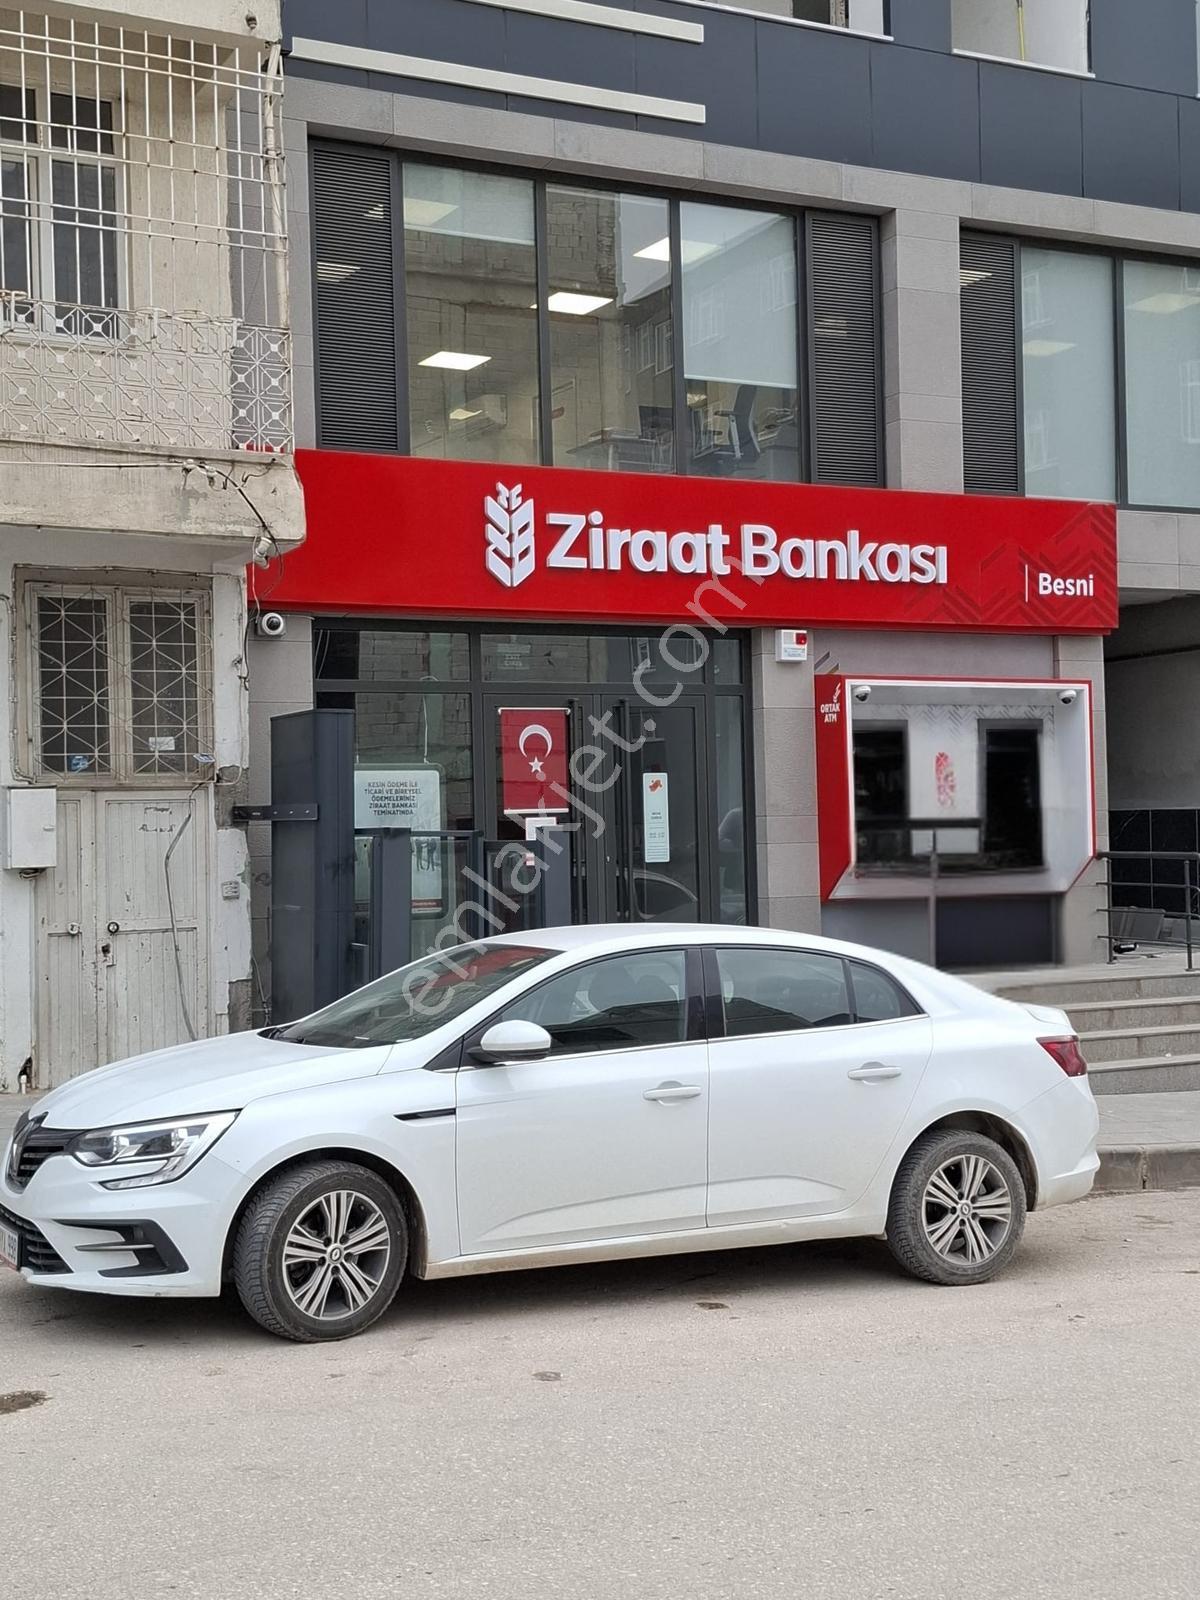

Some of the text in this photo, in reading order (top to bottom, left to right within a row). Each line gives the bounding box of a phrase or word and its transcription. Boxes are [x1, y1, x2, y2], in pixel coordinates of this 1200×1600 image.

[546, 511, 948, 584] Ziraat Bankası
[1038, 572, 1094, 596] Besni
[820, 703, 841, 713] ORTAK
[824, 713, 838, 723] ATM
